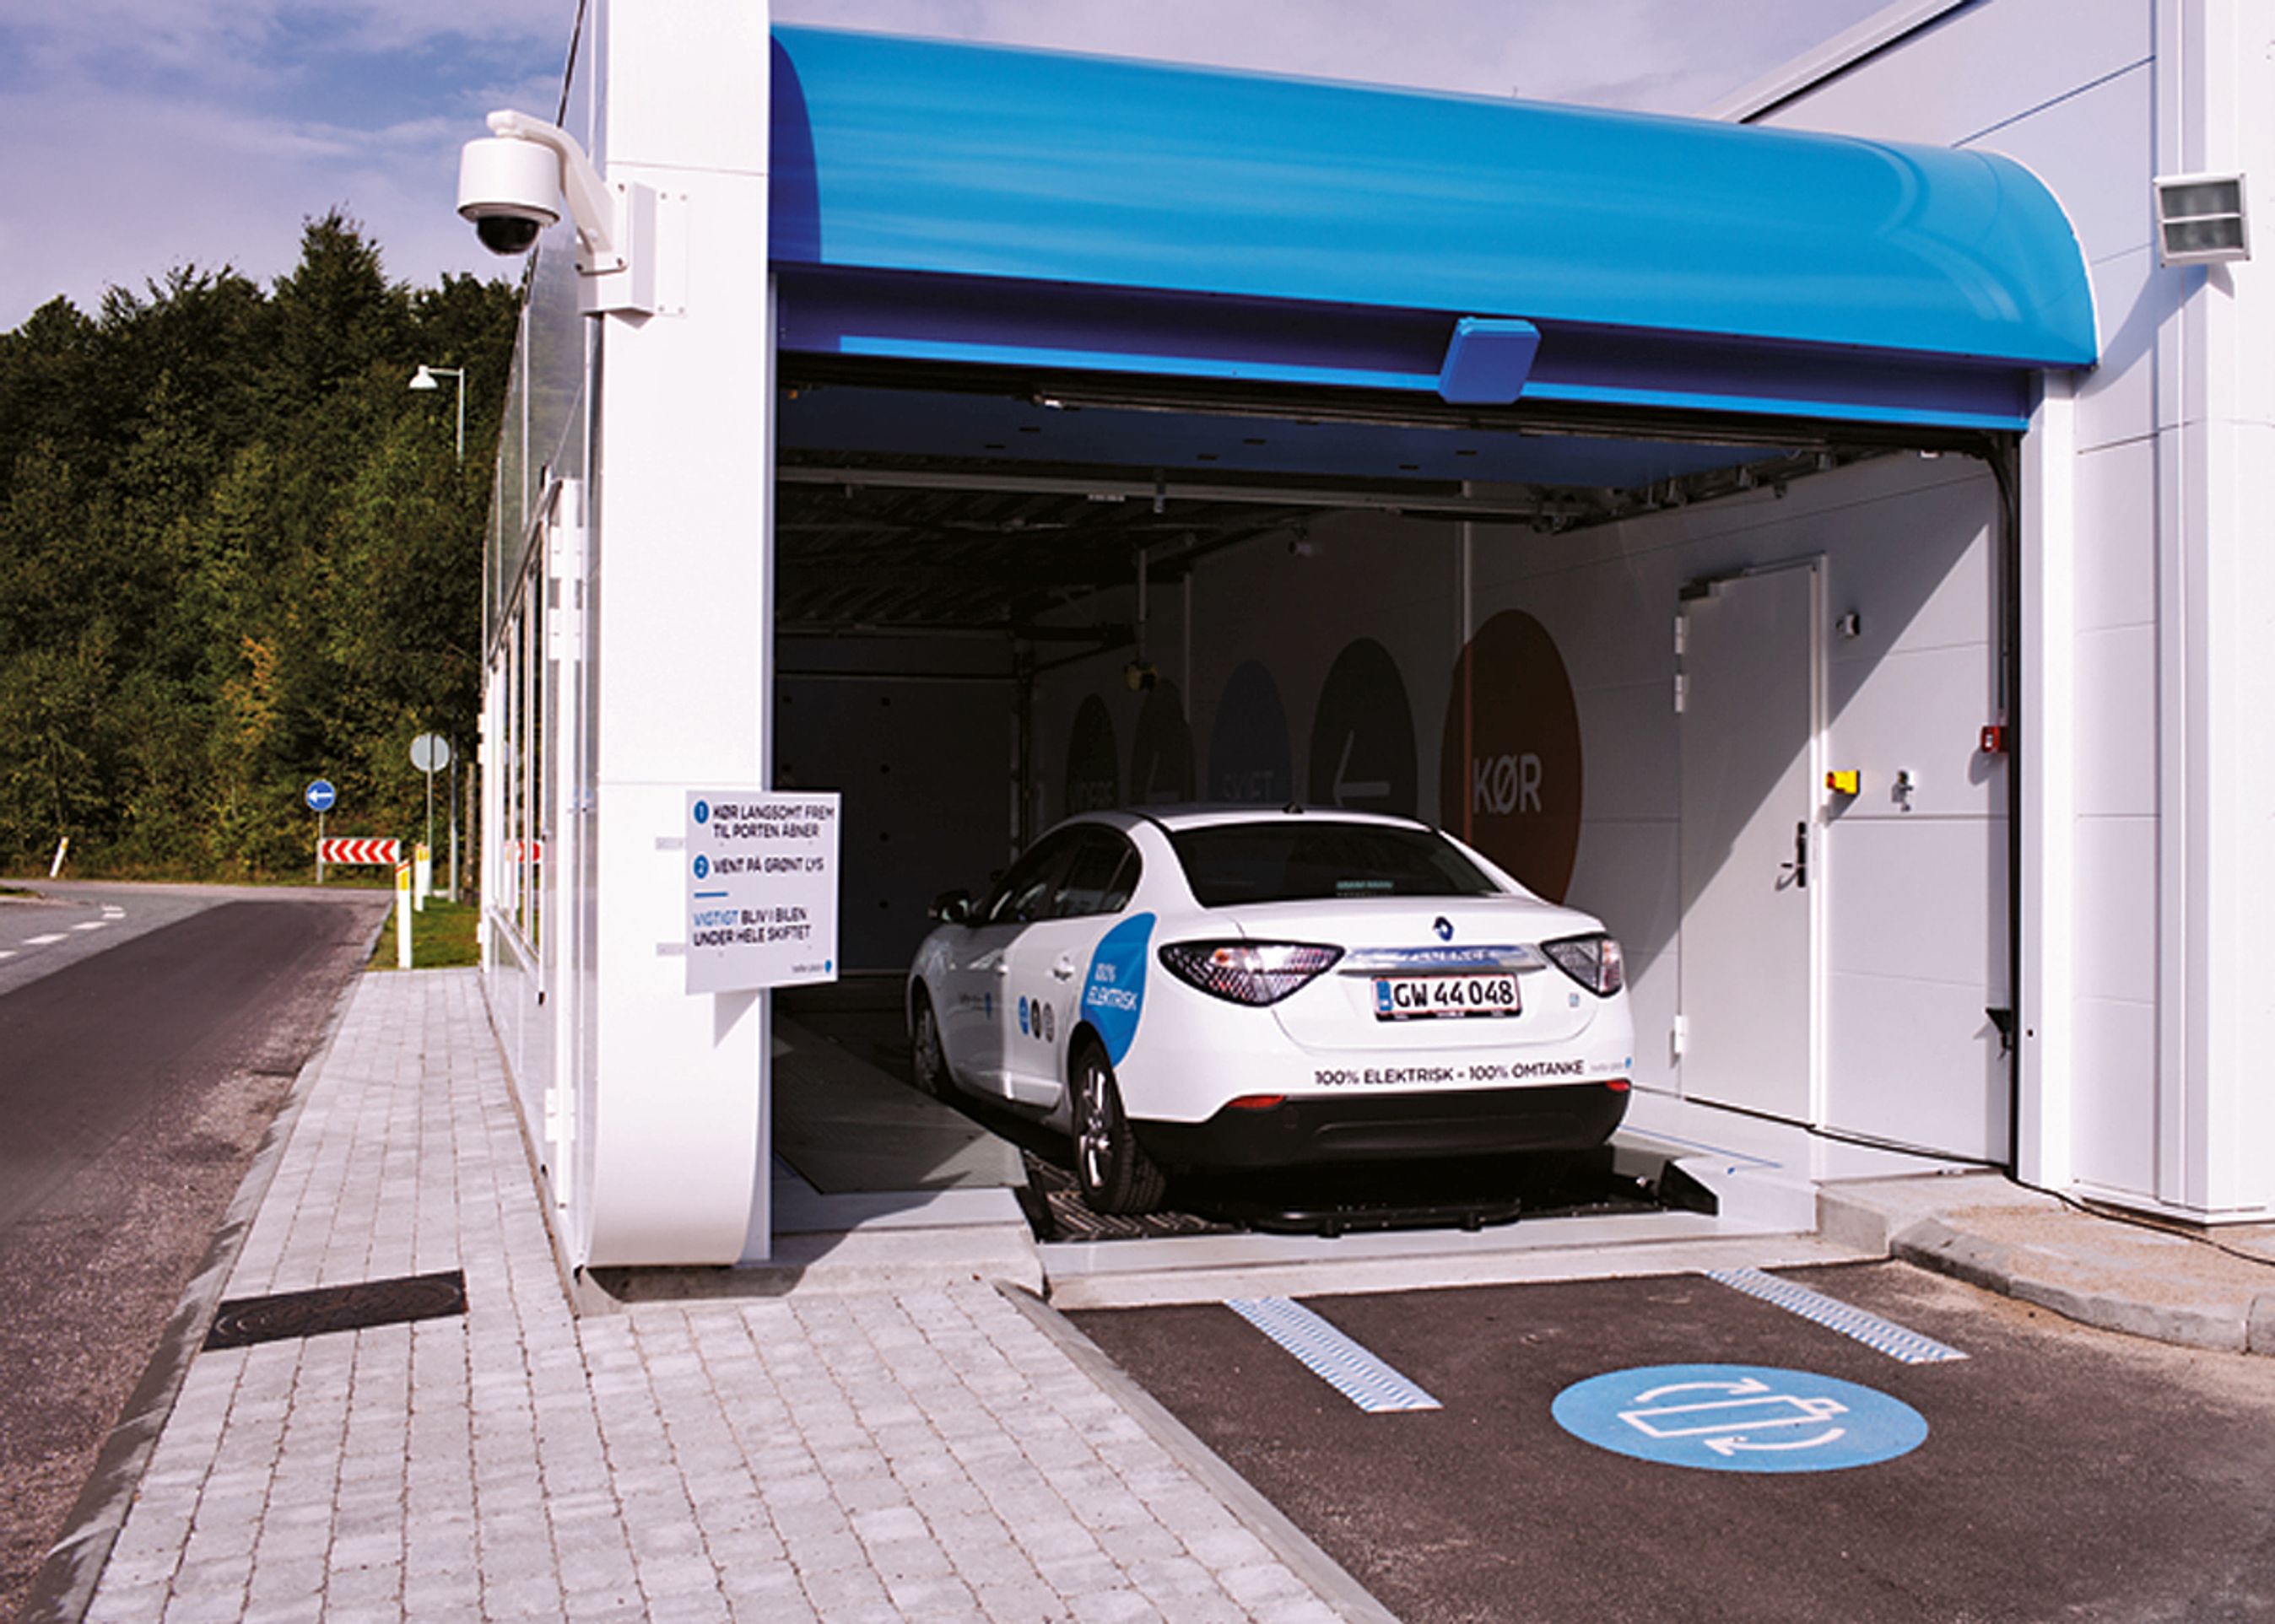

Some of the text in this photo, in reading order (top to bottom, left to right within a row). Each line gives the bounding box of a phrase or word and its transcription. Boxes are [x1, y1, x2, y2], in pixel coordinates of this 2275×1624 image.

[1473, 753, 1542, 815] KØR
[714, 805, 738, 820] KØR
[741, 805, 802, 820] LANGSOMT
[805, 805, 835, 820] FREM
[714, 823, 731, 839] TIL
[732, 823, 780, 839] PORTEN
[713, 858, 743, 874] VENT
[805, 857, 824, 872] LYS
[775, 907, 808, 923] BILEN
[694, 925, 811, 947] UNDER HELE SKIFTET
[1393, 979, 1514, 1007] GW 44 048
[1315, 1069, 1359, 1086] 100%
[1364, 1067, 1453, 1084] ELEKTRISK
[1469, 1065, 1508, 1081] 100%
[1511, 1060, 1585, 1078] OMTANKE
